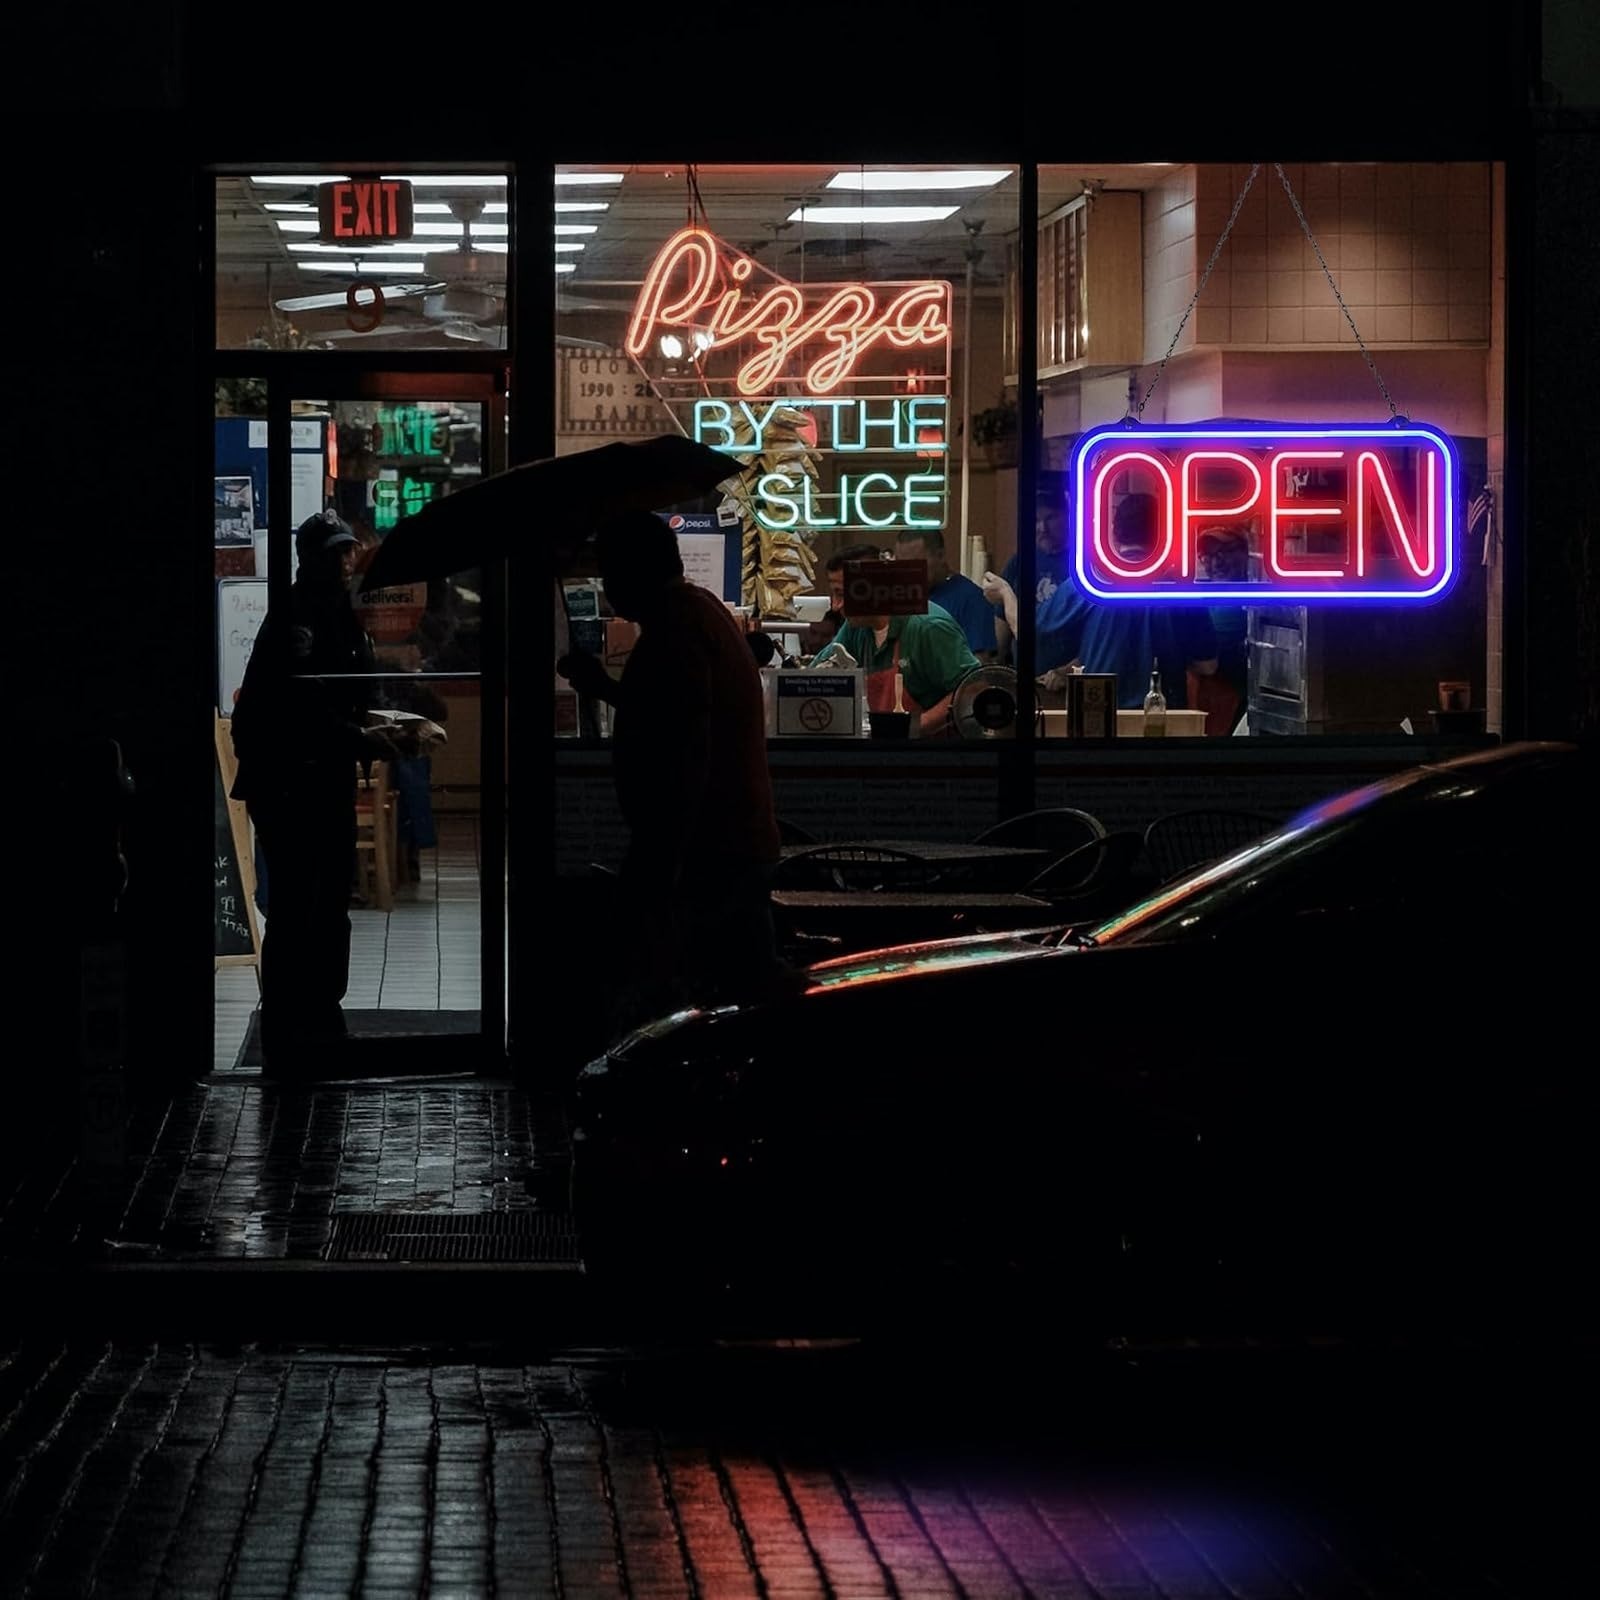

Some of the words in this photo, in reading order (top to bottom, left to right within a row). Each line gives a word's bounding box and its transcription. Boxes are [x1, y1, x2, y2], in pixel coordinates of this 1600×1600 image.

[333, 183, 400, 238] EXIT
[346, 282, 385, 333] 9
[625, 228, 948, 395] Pizza
[580, 383, 614, 397] 1990
[693, 398, 782, 453] BY
[815, 398, 948, 451] THE
[685, 519, 711, 529] pepsi
[757, 473, 945, 528] SLICE
[1092, 450, 1436, 577] OPEN
[848, 578, 923, 609] Open
